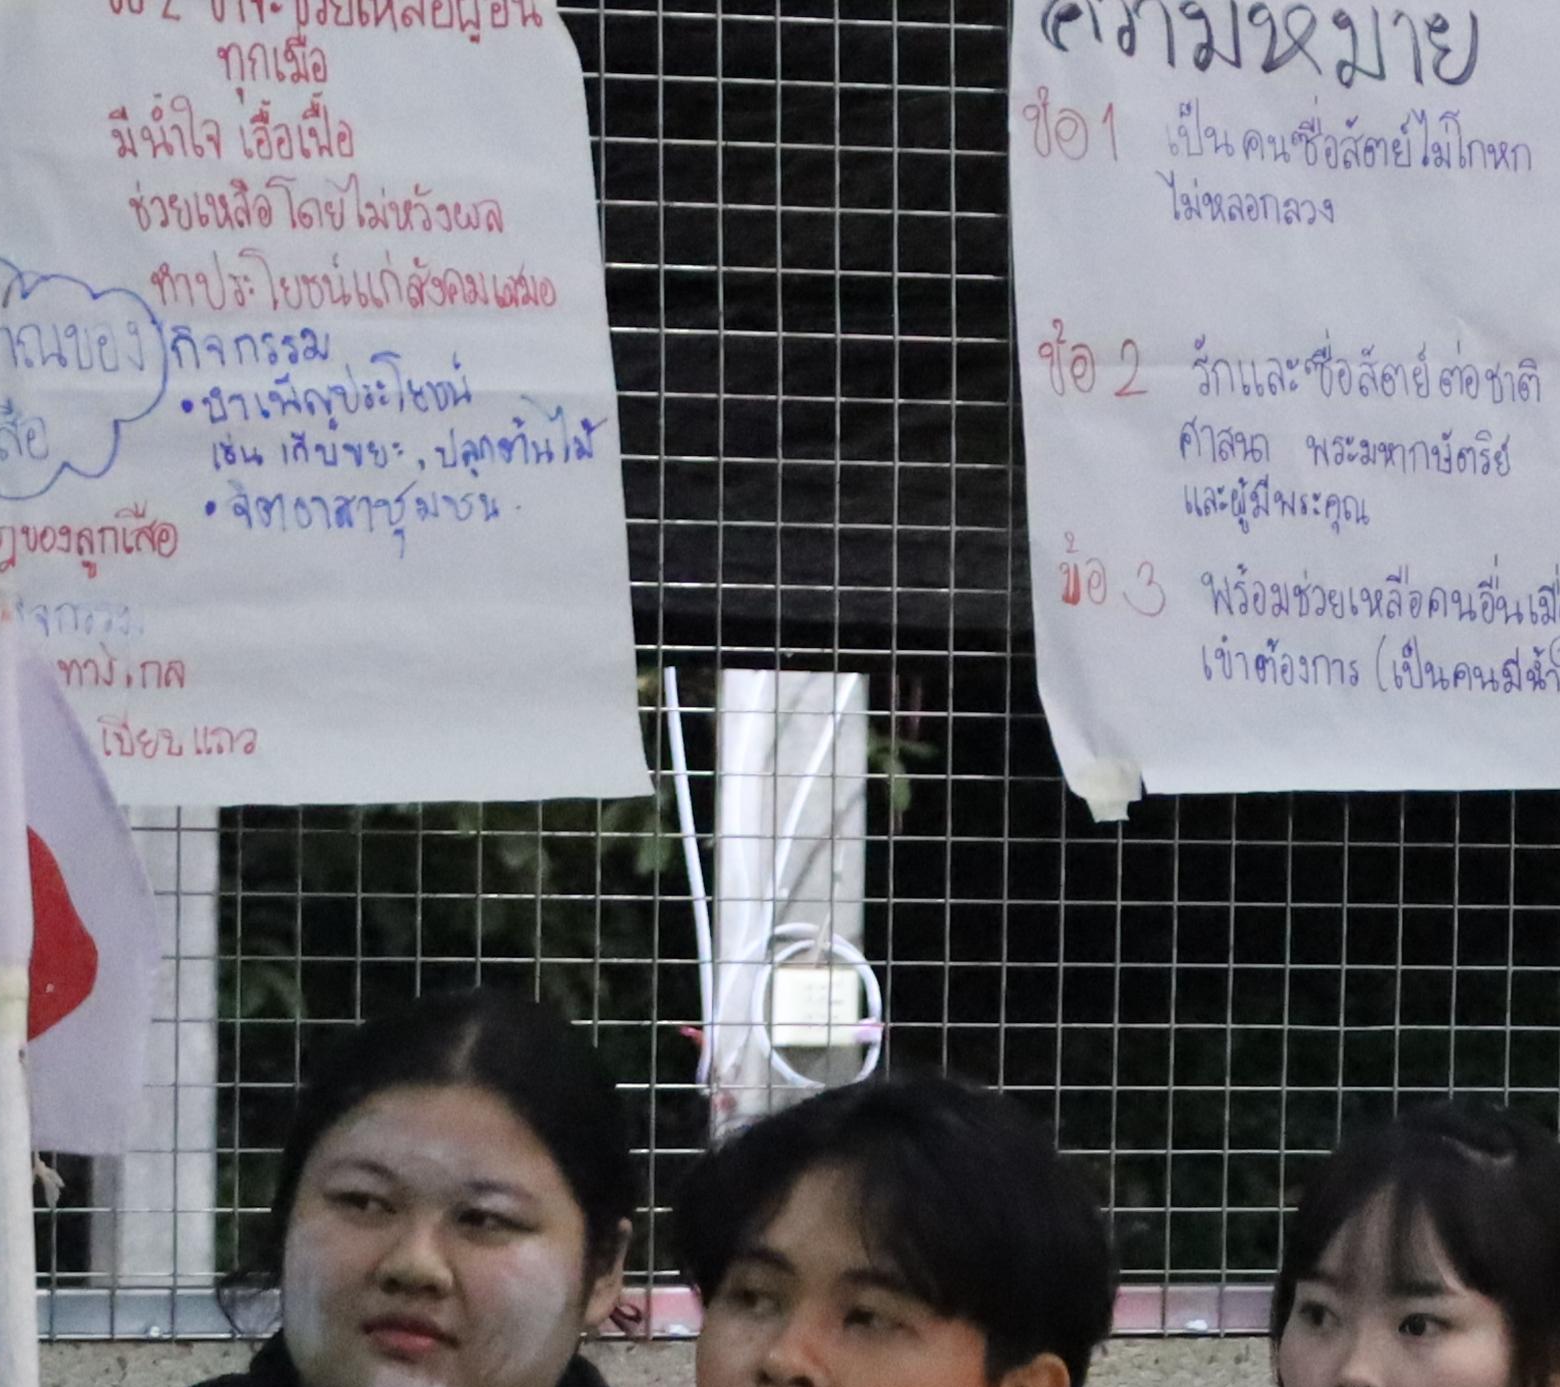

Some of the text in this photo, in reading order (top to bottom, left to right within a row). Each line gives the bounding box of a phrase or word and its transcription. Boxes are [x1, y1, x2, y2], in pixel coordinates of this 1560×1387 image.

[1154, 169, 1337, 227] ไม่หลอกลวง
[170, 323, 331, 369] กิจกรรม
[1180, 421, 1271, 468] ศาสนา
